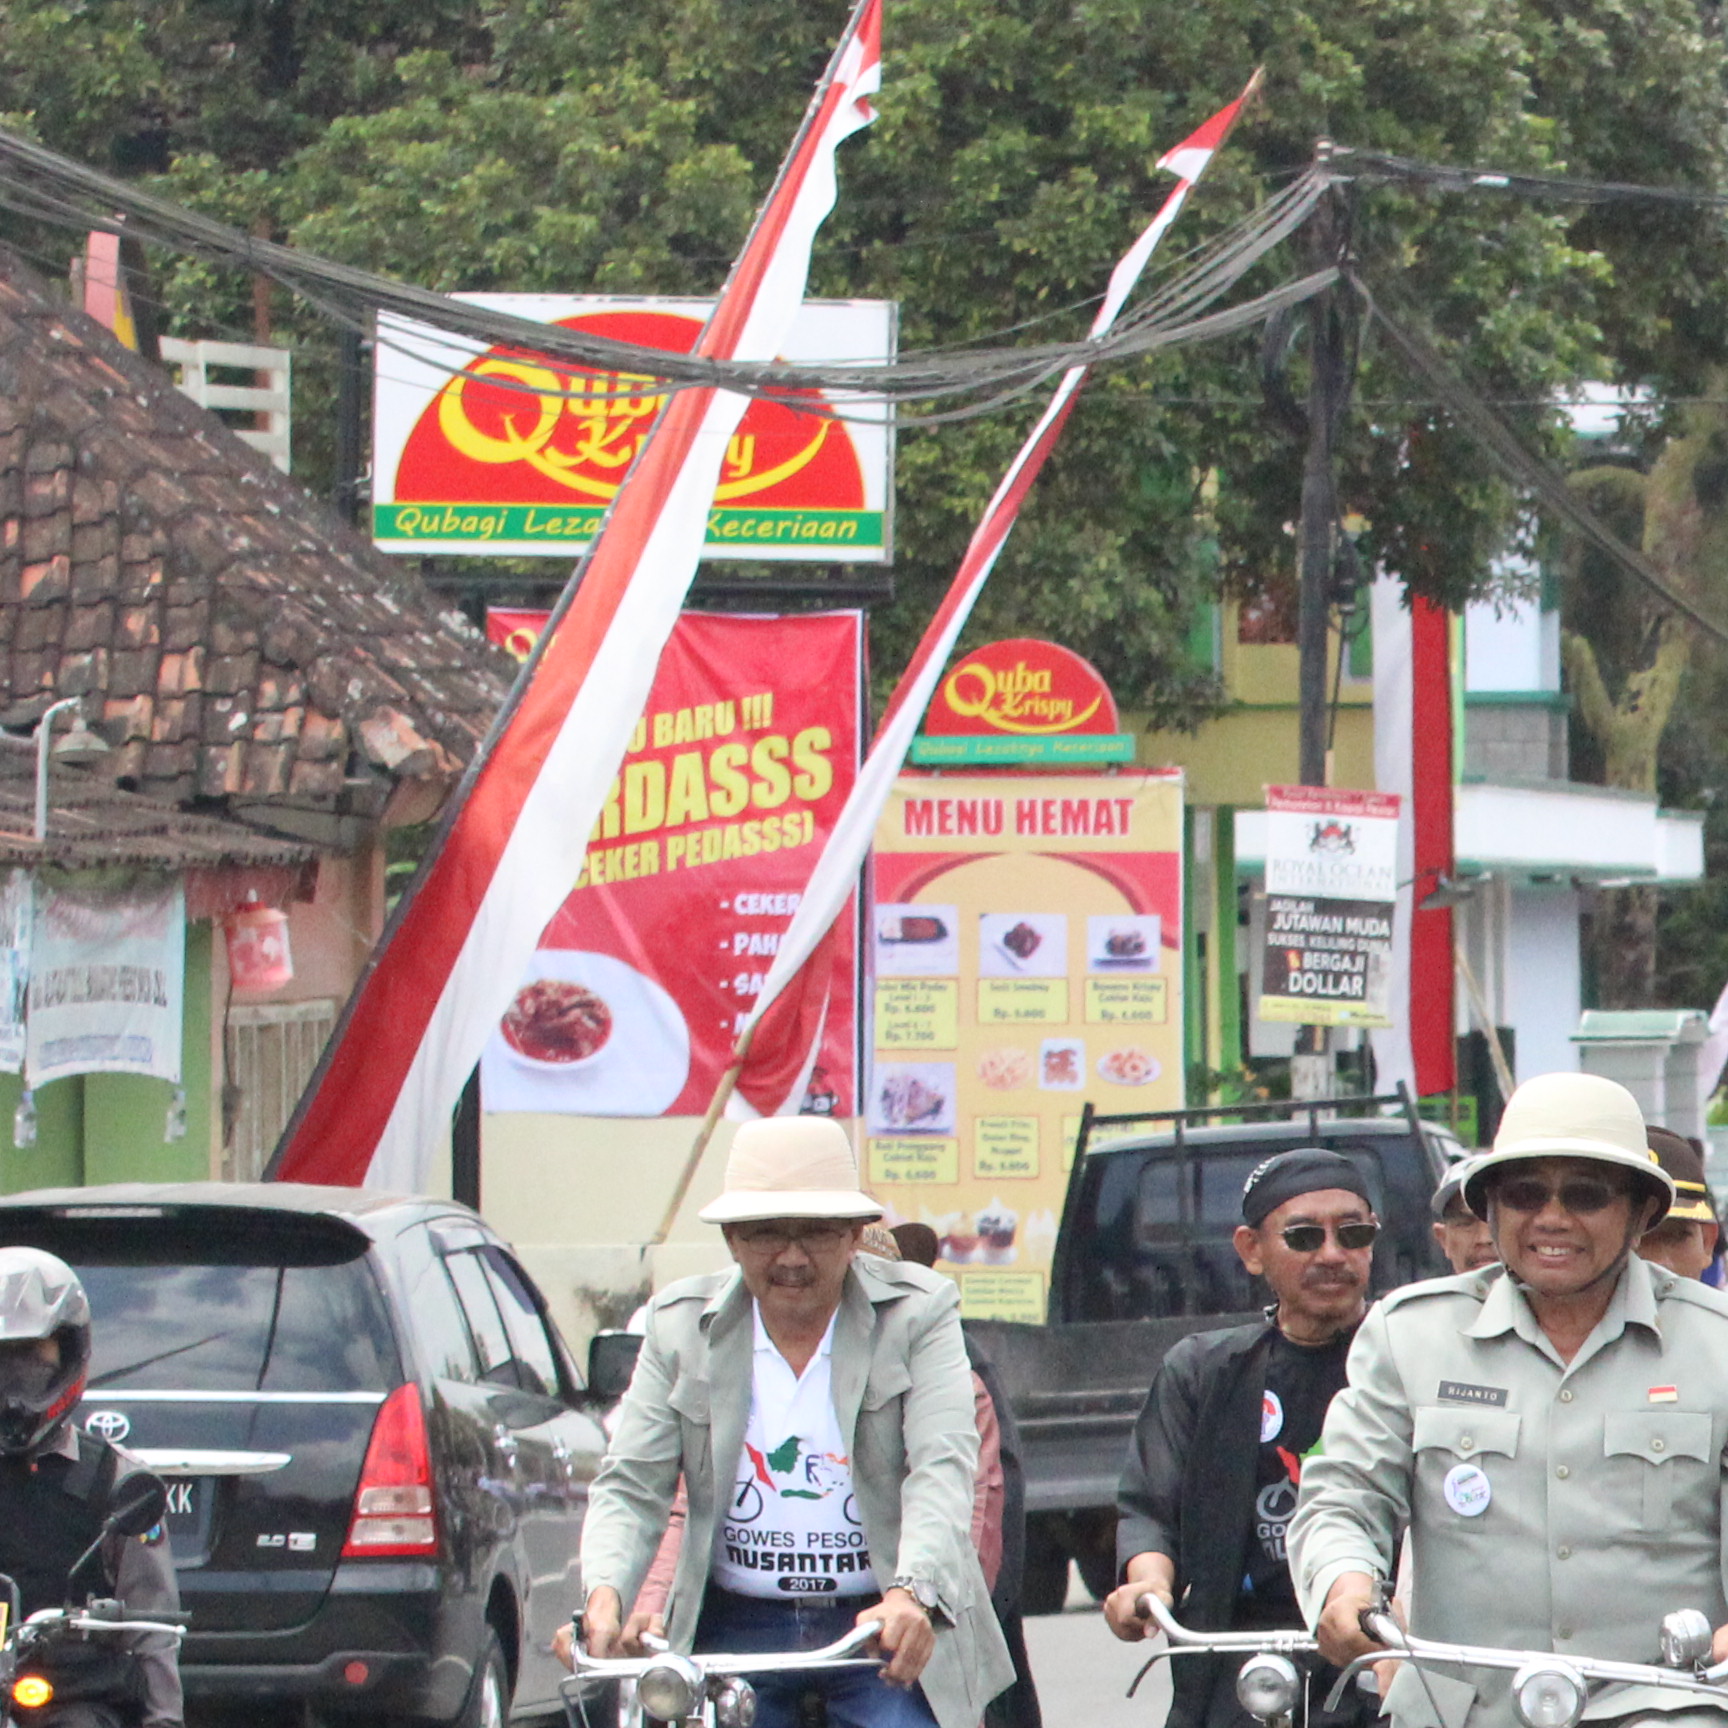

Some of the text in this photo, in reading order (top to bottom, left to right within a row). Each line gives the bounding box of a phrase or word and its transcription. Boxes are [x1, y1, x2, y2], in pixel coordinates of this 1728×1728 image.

[395, 507, 507, 540] Qubagi
[524, 508, 604, 535] Leza
[653, 702, 736, 749] BARU
[904, 798, 1135, 836] MENU HEMAT
[734, 893, 802, 916] CEKER
[1272, 911, 1391, 937] JUTAWAN MUDA
[1302, 951, 1367, 973] BERGAJI
[1288, 971, 1364, 996] DOLLAR
[723, 1526, 868, 1549] GOWES PESO
[789, 1577, 827, 1592] 2017
